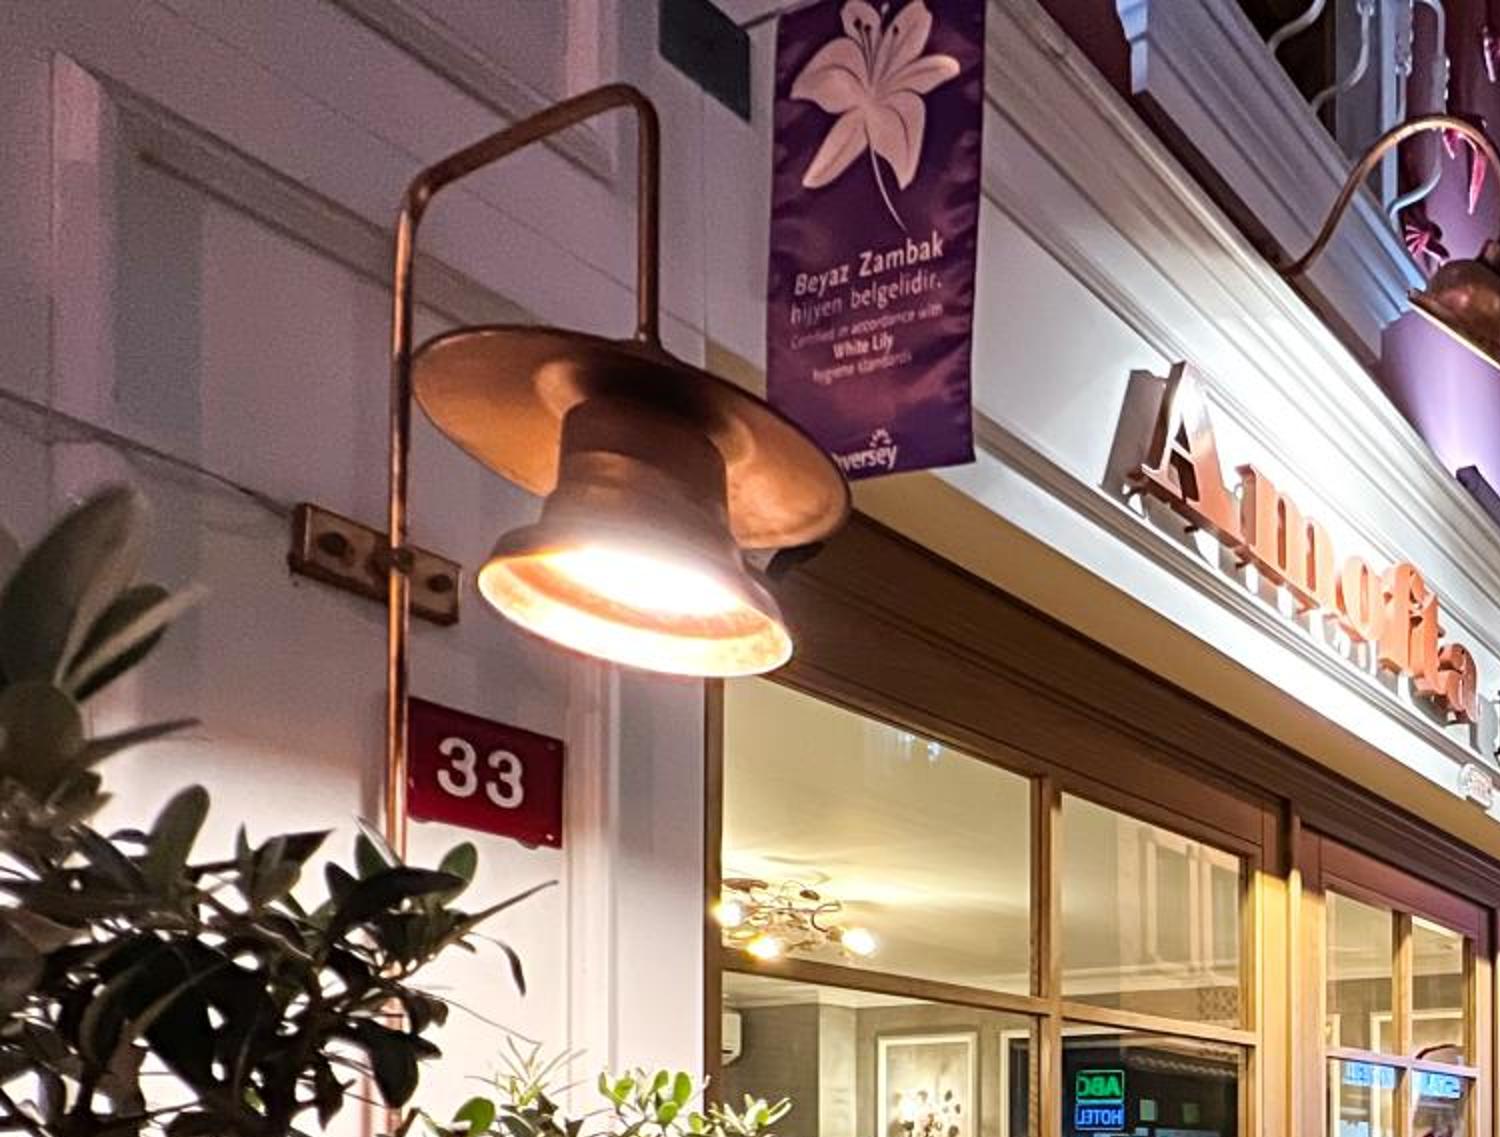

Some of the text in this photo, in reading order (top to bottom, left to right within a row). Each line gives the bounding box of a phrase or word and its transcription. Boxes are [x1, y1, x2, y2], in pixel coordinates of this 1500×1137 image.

[794, 230, 944, 298] Beyaz Zambak
[790, 268, 942, 326] hijyen belgelidir.
[833, 331, 895, 359] White Lily
[436, 736, 524, 809] 33
